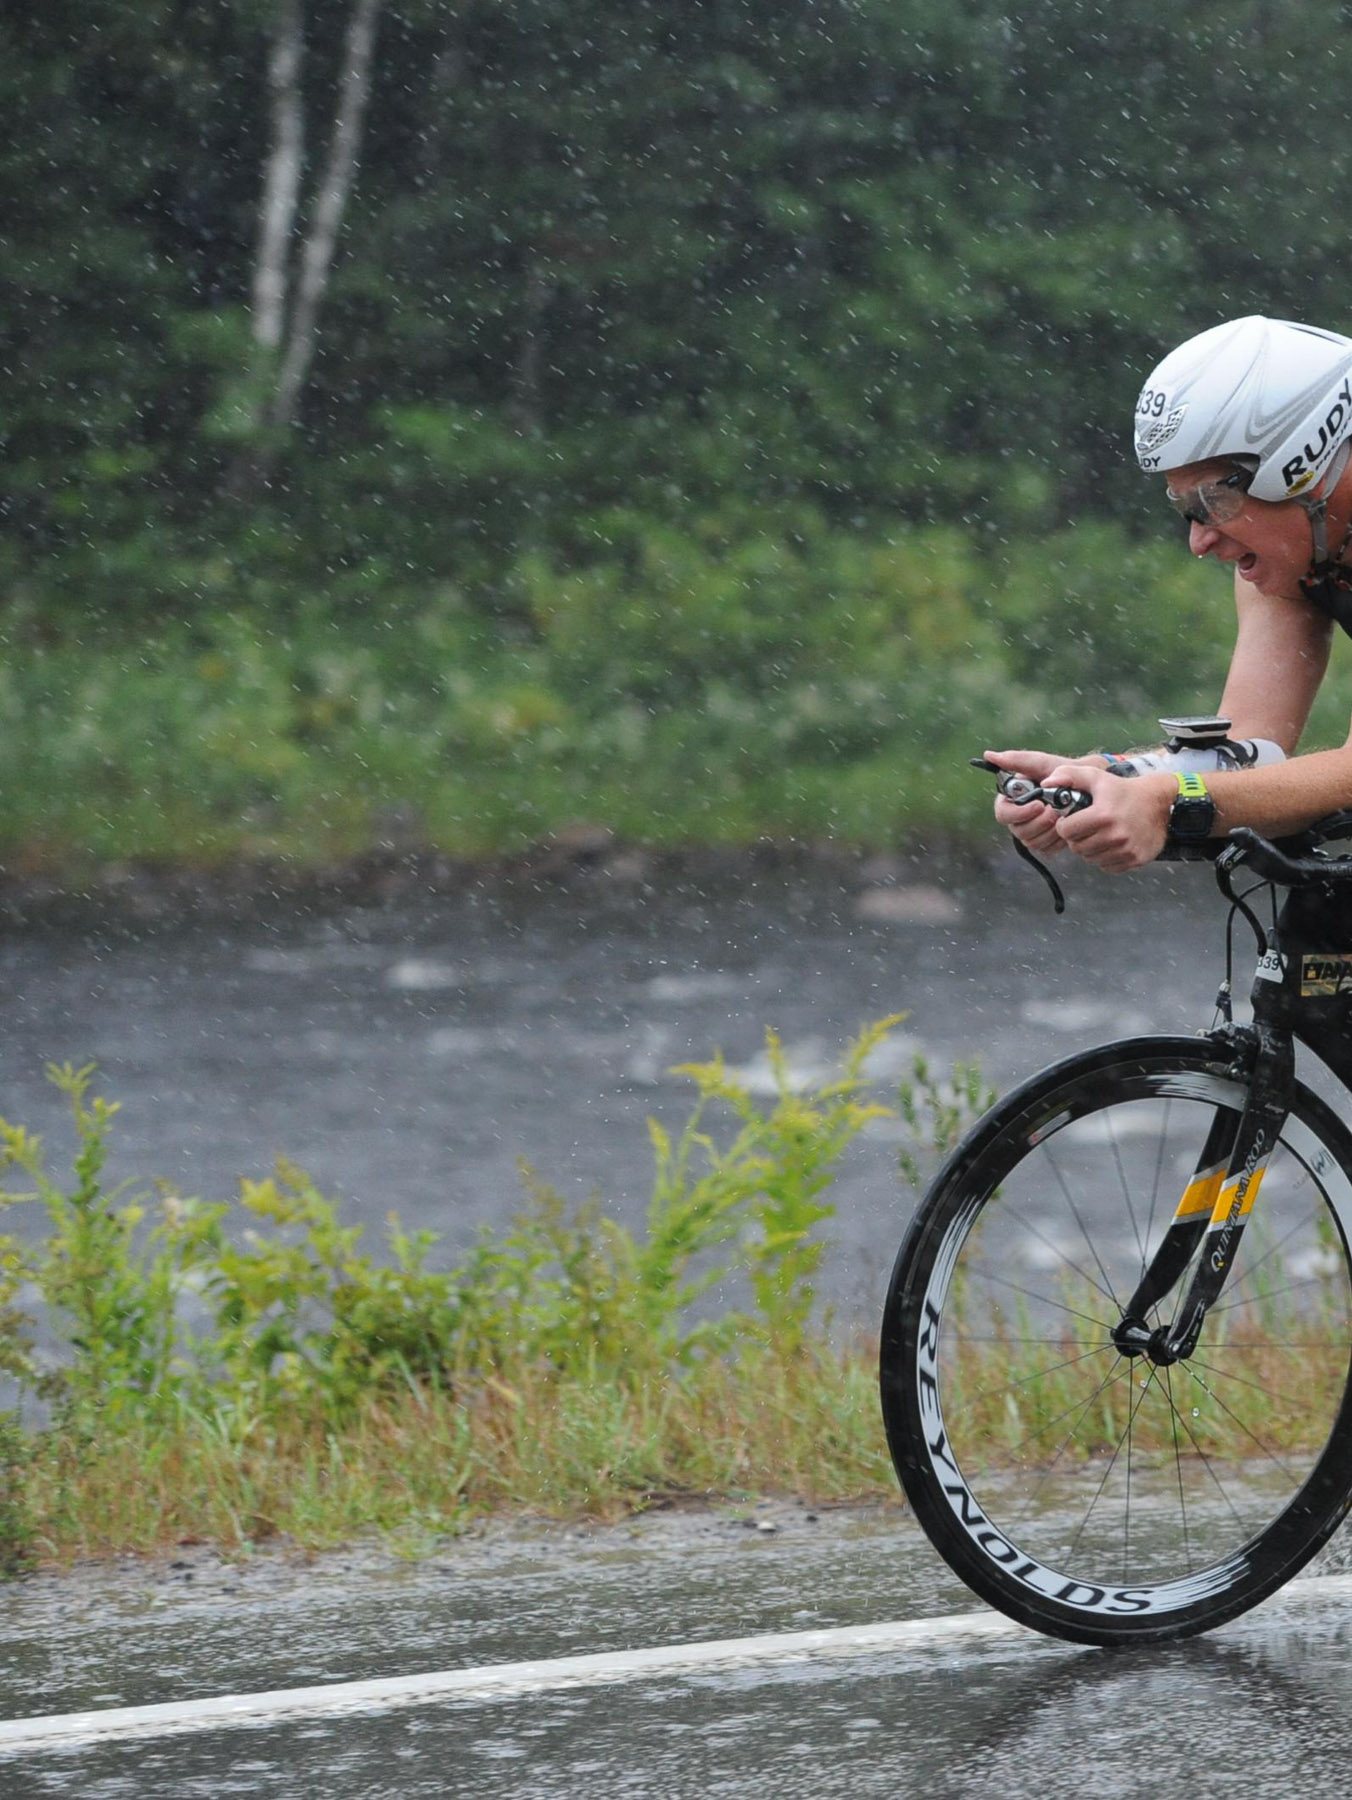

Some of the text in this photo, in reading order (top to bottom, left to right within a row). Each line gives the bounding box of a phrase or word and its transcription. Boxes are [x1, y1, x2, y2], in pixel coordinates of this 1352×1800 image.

[1136, 389, 1166, 417] 39
[1282, 378, 1352, 487] RUDY
[1140, 455, 1161, 468] DY
[1211, 1128, 1265, 1273] QUINTANA ROO
[919, 1300, 1156, 1613] REYNOLDS
